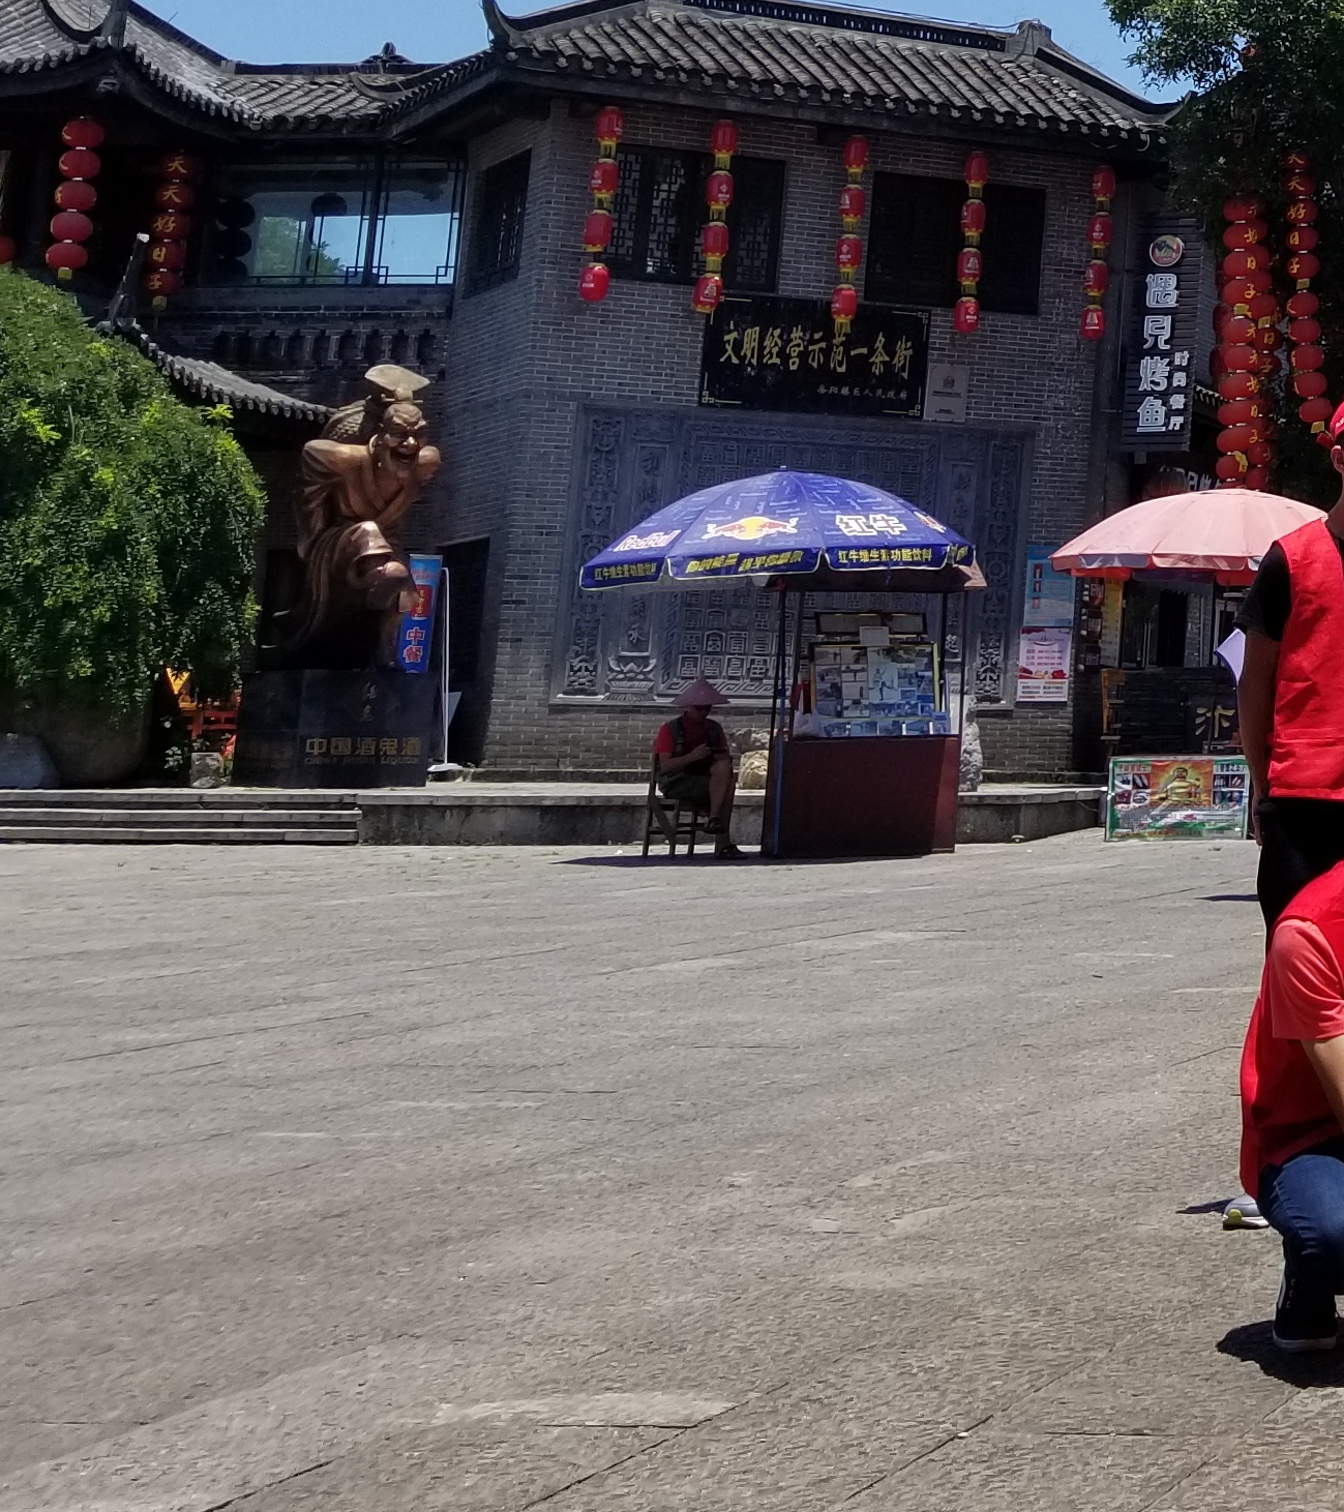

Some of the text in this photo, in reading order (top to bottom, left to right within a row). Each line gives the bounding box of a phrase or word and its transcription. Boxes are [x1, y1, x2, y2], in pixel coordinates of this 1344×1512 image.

[147, 155, 187, 290] 天天好日子
[719, 319, 914, 380] 文明经营示范一条街
[834, 513, 908, 537] 红牛
